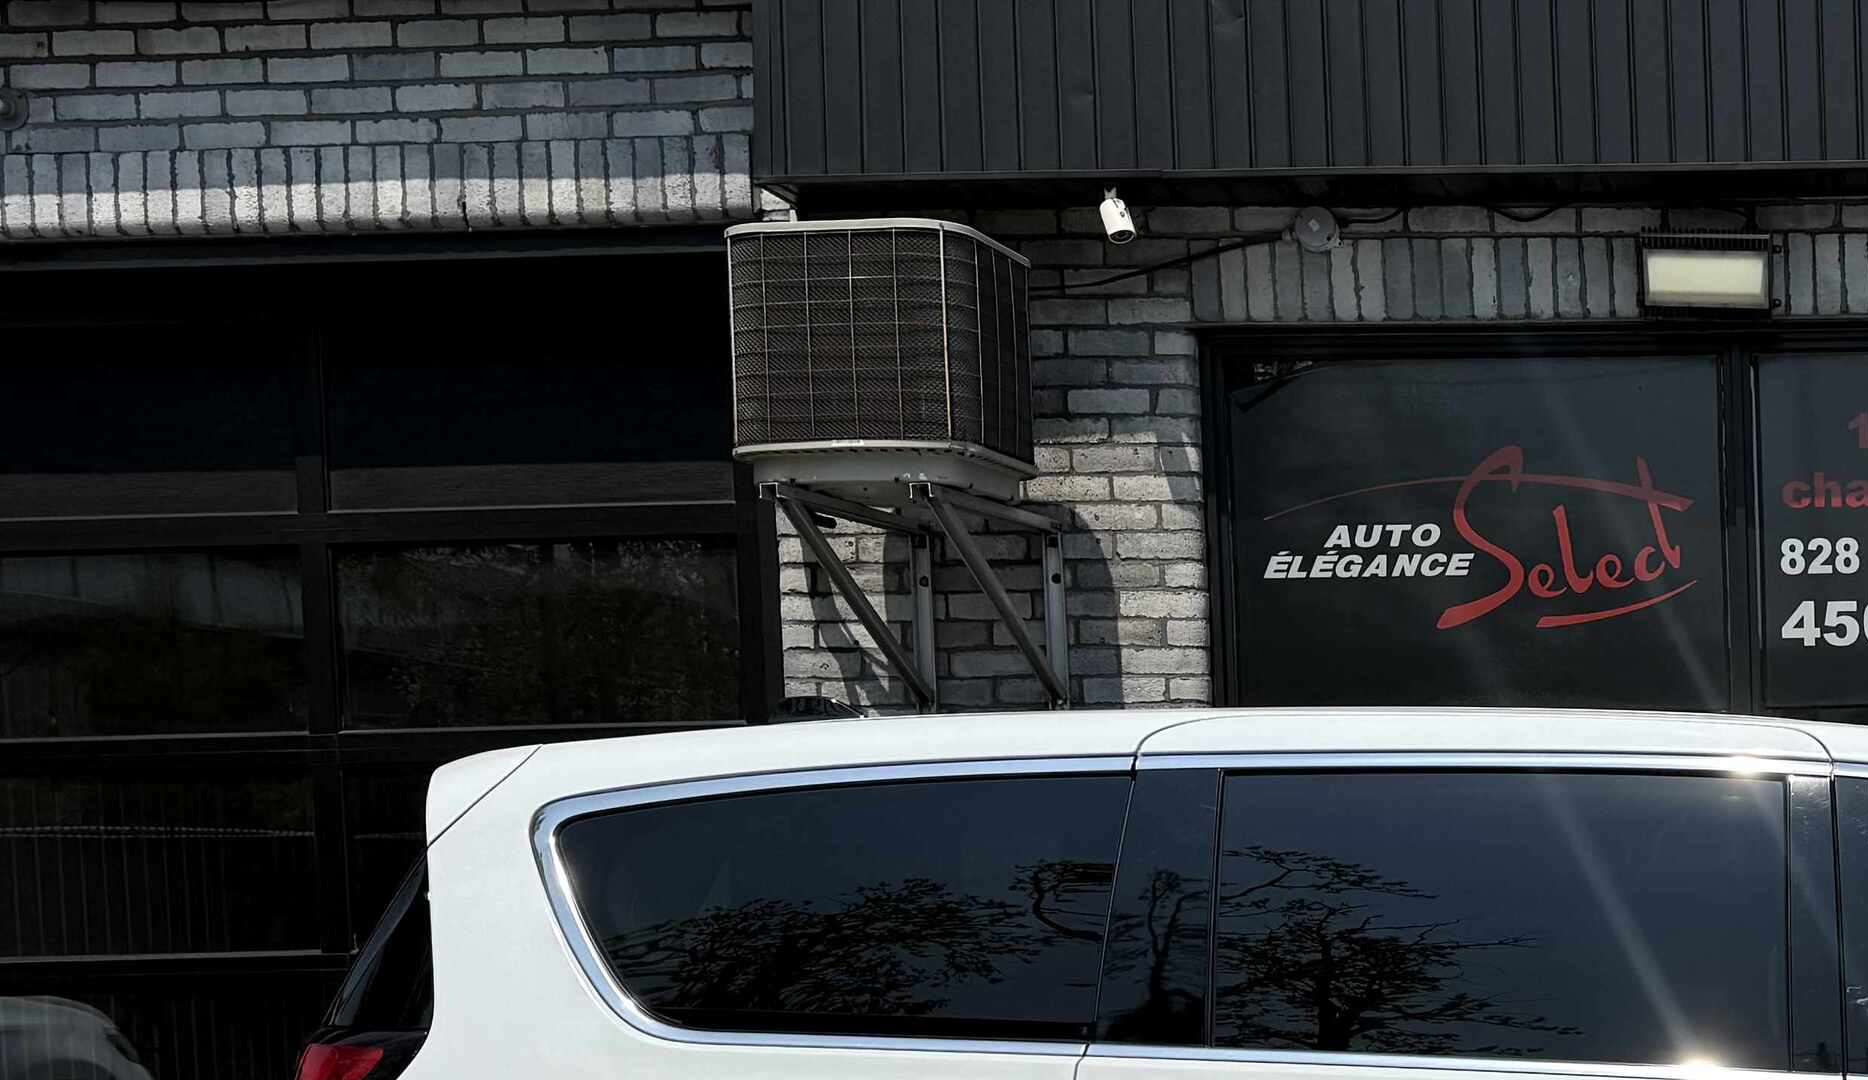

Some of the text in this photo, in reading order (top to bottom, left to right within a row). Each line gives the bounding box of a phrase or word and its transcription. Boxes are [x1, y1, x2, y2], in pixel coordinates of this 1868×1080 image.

[1323, 523, 1441, 548] AUTO
[1437, 446, 1696, 629] Select
[1263, 550, 1475, 579] ÉLÉGANCE
[1779, 537, 1861, 576] 828
